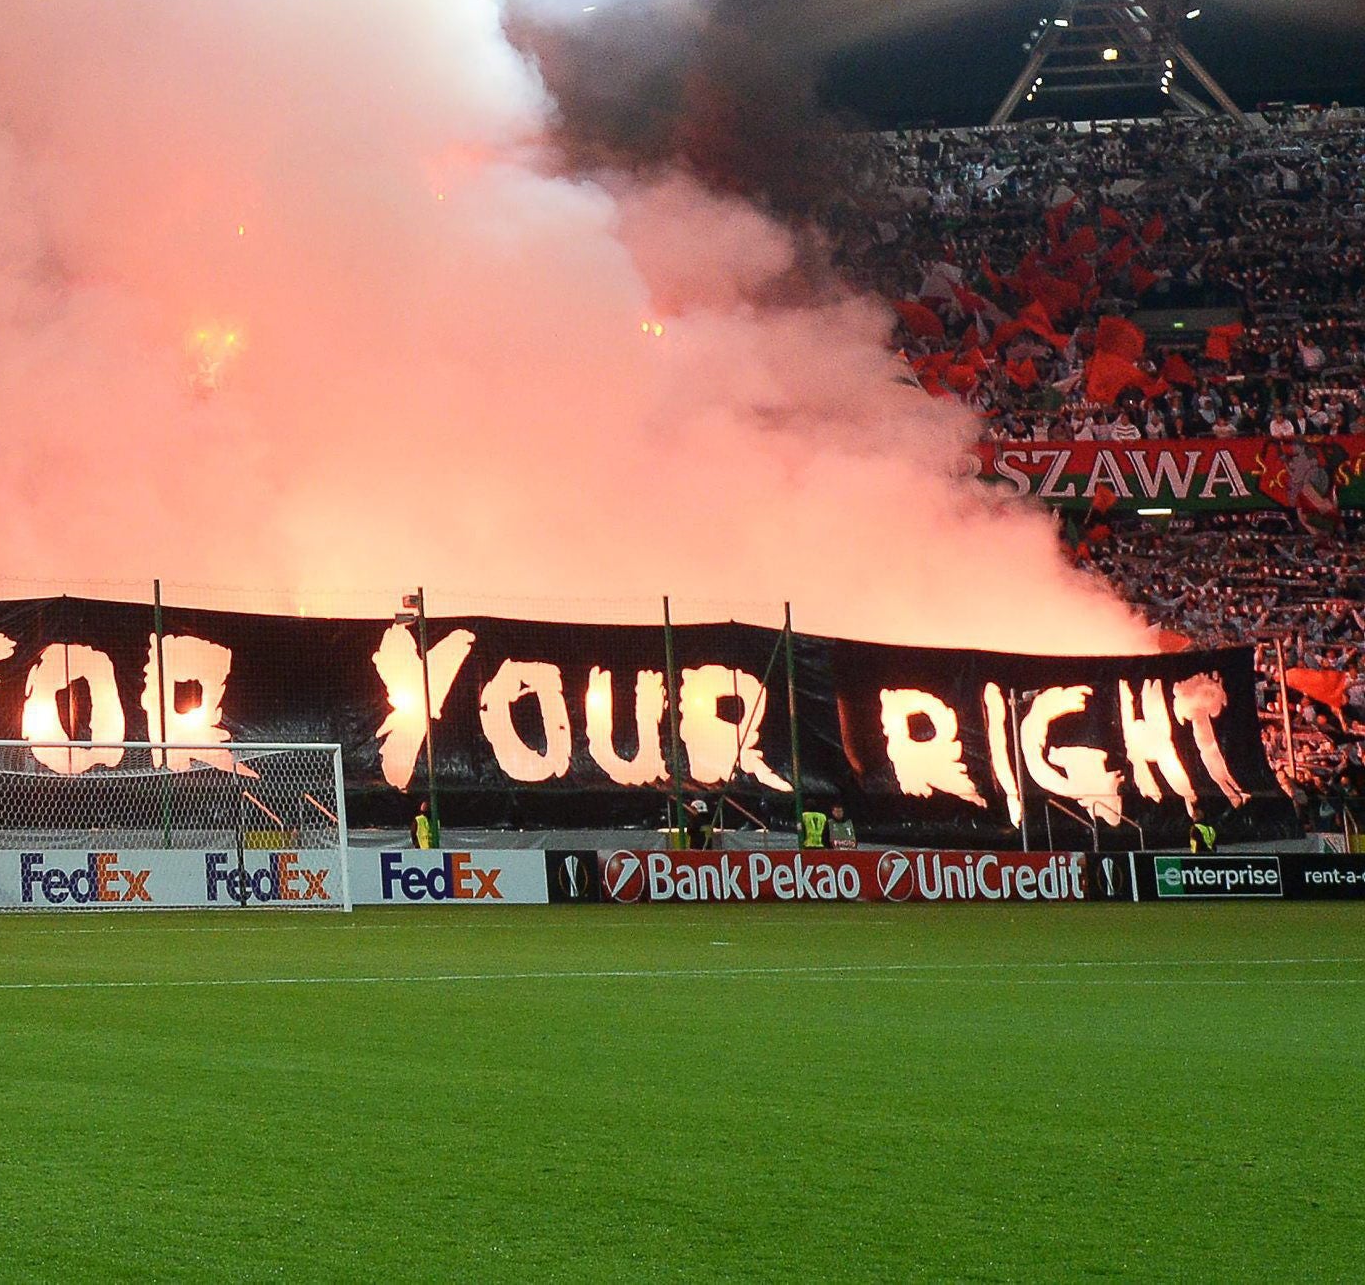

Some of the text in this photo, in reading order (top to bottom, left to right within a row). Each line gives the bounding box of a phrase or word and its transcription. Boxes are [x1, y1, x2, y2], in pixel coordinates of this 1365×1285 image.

[373, 623, 795, 792] YOUR
[879, 673, 1252, 828] RIGHT
[20, 852, 153, 903] FedEx
[205, 852, 331, 901] FedEx
[381, 852, 504, 900] FedEx
[647, 851, 861, 901] Bank Pekao
[915, 853, 1086, 901] UniCredit
[1164, 864, 1279, 889] enterprise
